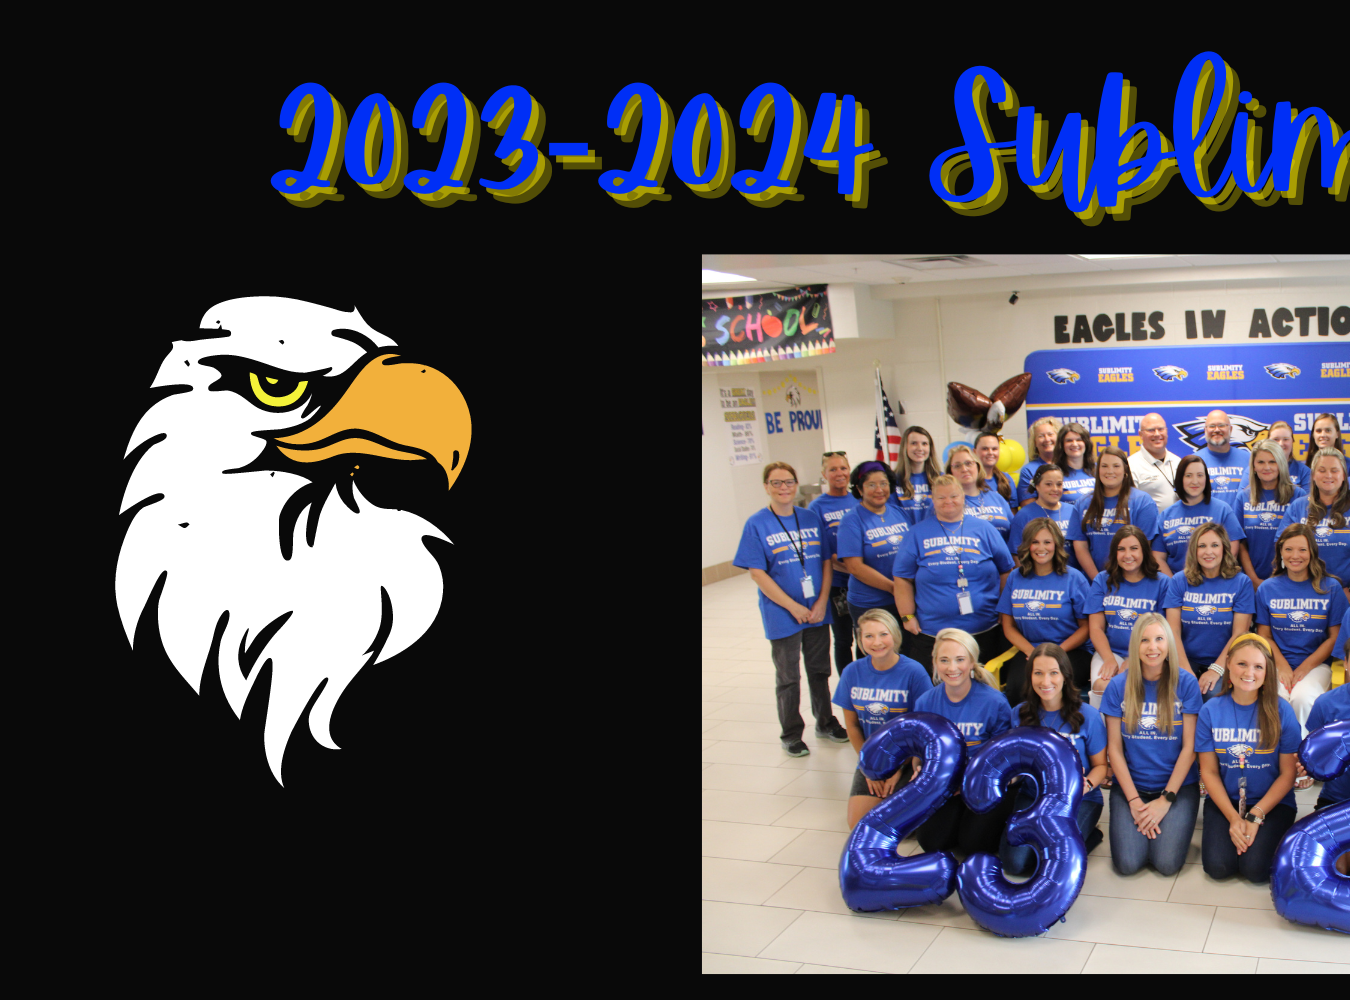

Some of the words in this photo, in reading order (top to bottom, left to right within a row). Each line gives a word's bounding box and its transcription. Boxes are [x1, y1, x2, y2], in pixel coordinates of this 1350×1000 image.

[715, 305, 819, 346] SCHOOL
[1054, 311, 1165, 344] EAGLES
[1185, 310, 1226, 340] IN
[1098, 366, 1132, 374] SUBLIMITY
[1206, 370, 1245, 380] EAGLES
[1207, 364, 1243, 372] SUBLIMITY
[1098, 373, 1134, 383] EAGLES
[765, 411, 784, 434] BE
[1163, 515, 1213, 530] SUBLIMITY
[865, 521, 910, 541] SUBLIMITY
[922, 535, 982, 550] SUBLIMITY
[1011, 588, 1066, 601] SUBLIMITY
[1102, 594, 1158, 612] SUBLIMITY
[1269, 597, 1330, 611] SUBLIMITY
[850, 686, 910, 703] SUBLIMITY
